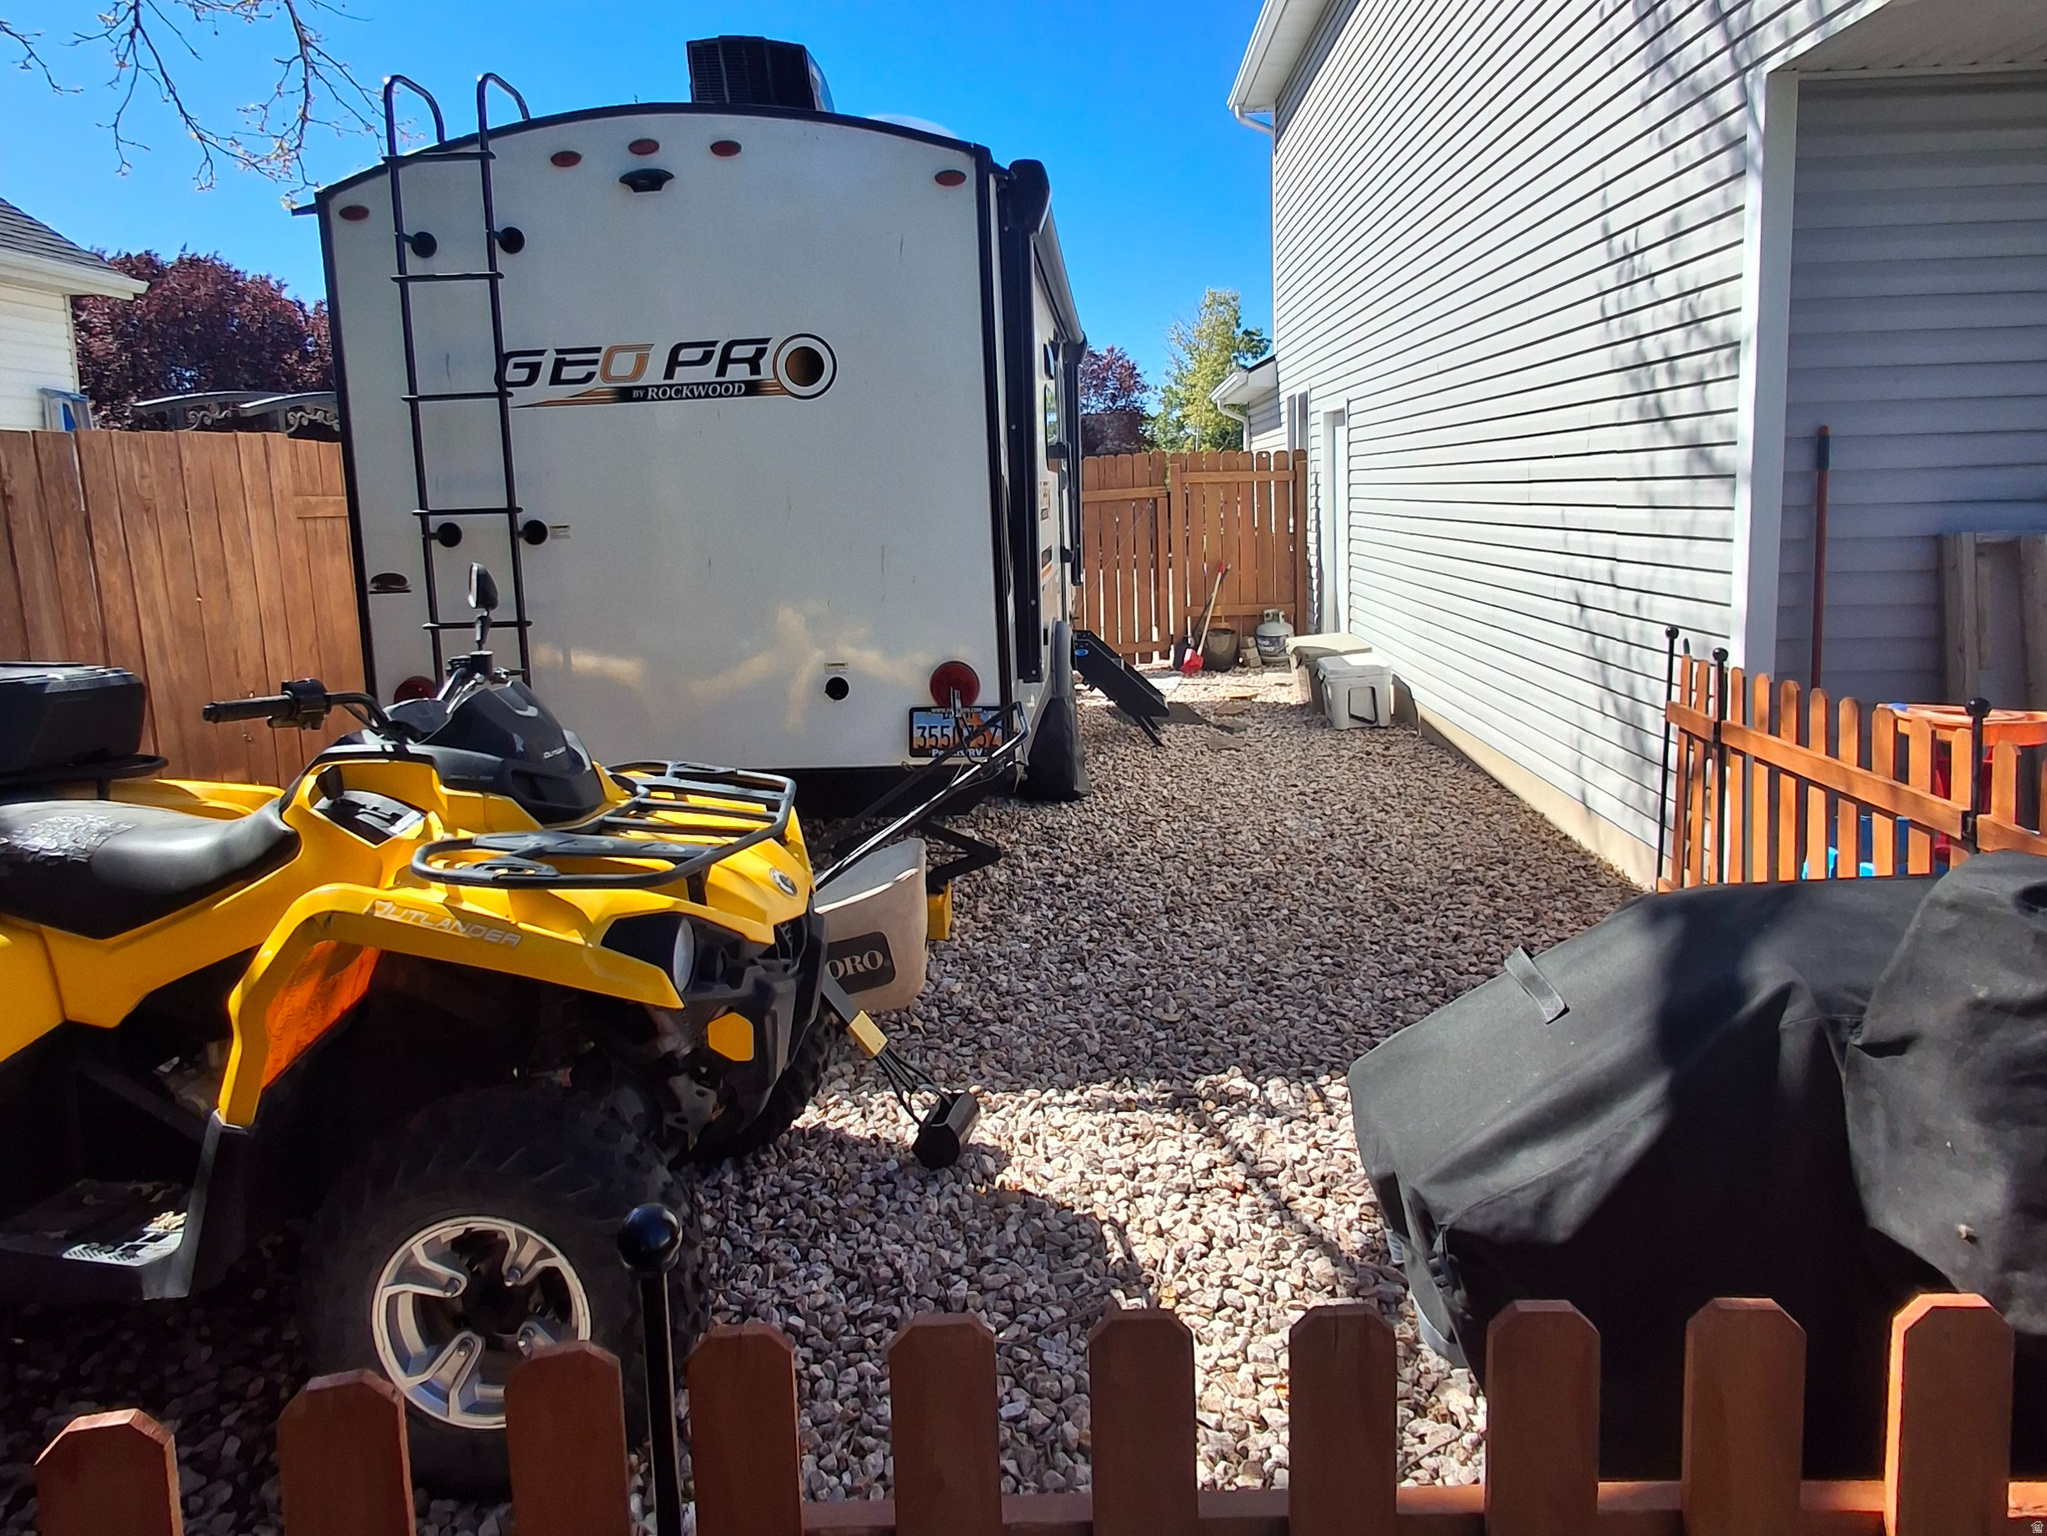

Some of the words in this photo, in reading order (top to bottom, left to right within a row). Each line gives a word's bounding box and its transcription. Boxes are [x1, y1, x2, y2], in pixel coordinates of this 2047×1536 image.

[495, 343, 654, 388] GEO
[632, 389, 646, 399] BY
[646, 382, 746, 400] ROCKWOOD
[373, 899, 522, 948] OUTLANDER
[824, 949, 884, 980] ORO
